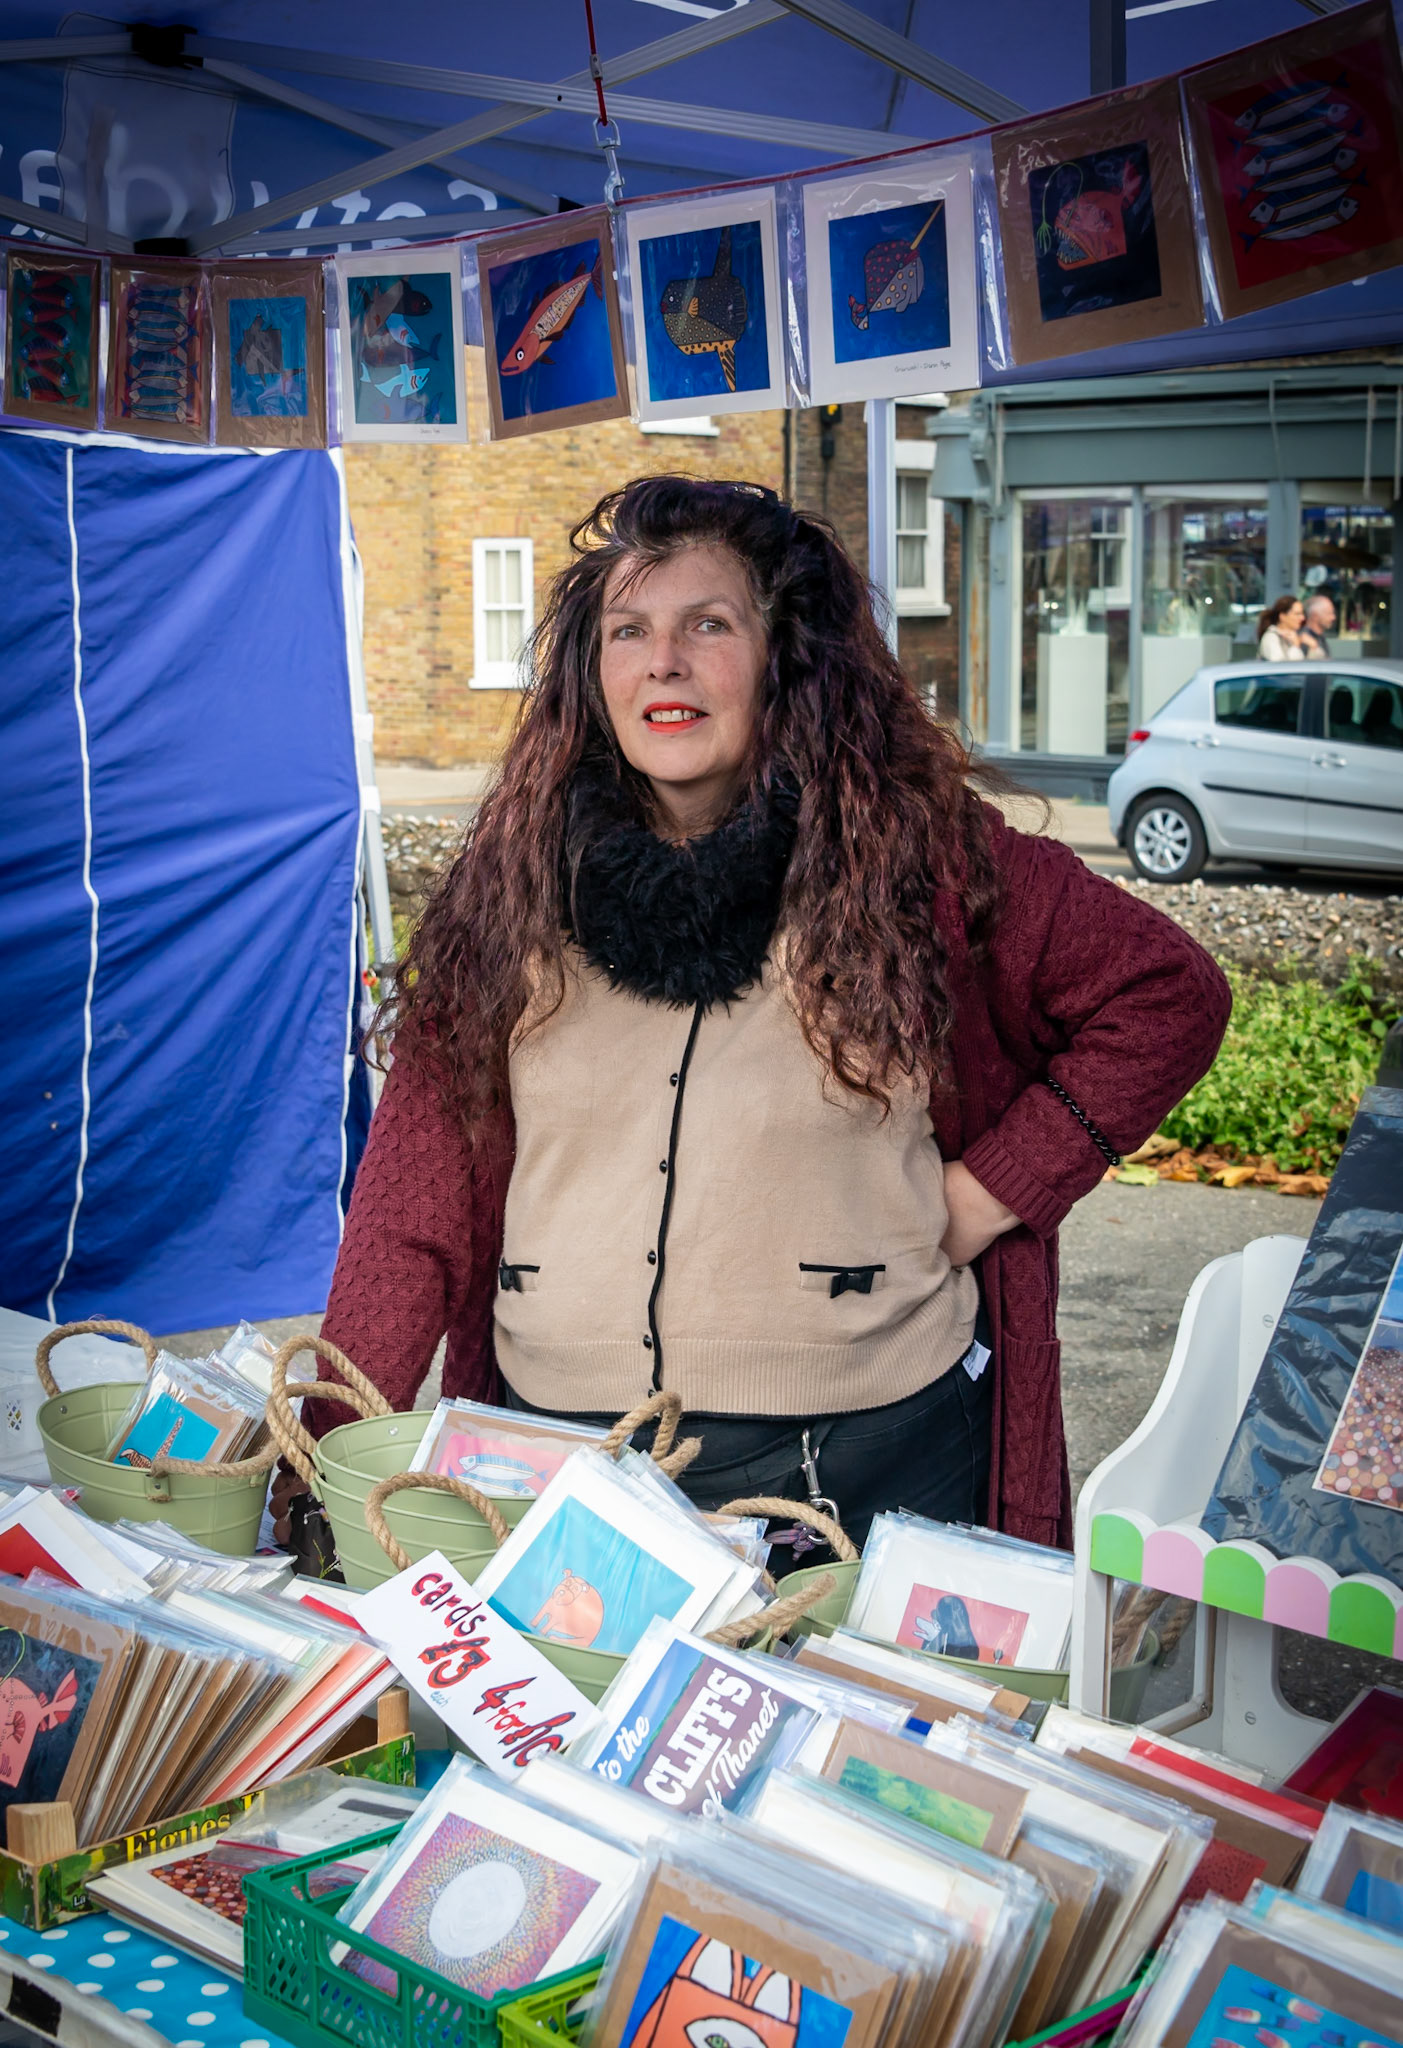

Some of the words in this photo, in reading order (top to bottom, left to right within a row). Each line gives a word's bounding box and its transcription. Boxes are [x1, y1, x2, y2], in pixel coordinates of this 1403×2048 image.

[411, 1573, 487, 1637] cards
[473, 1676, 538, 1715] 4
[485, 1700, 527, 1734] for
[615, 1715, 650, 1762] the
[643, 1667, 752, 1805] CLIFFS
[711, 1688, 780, 1790] Thanet
[124, 1812, 232, 1862] Figues
